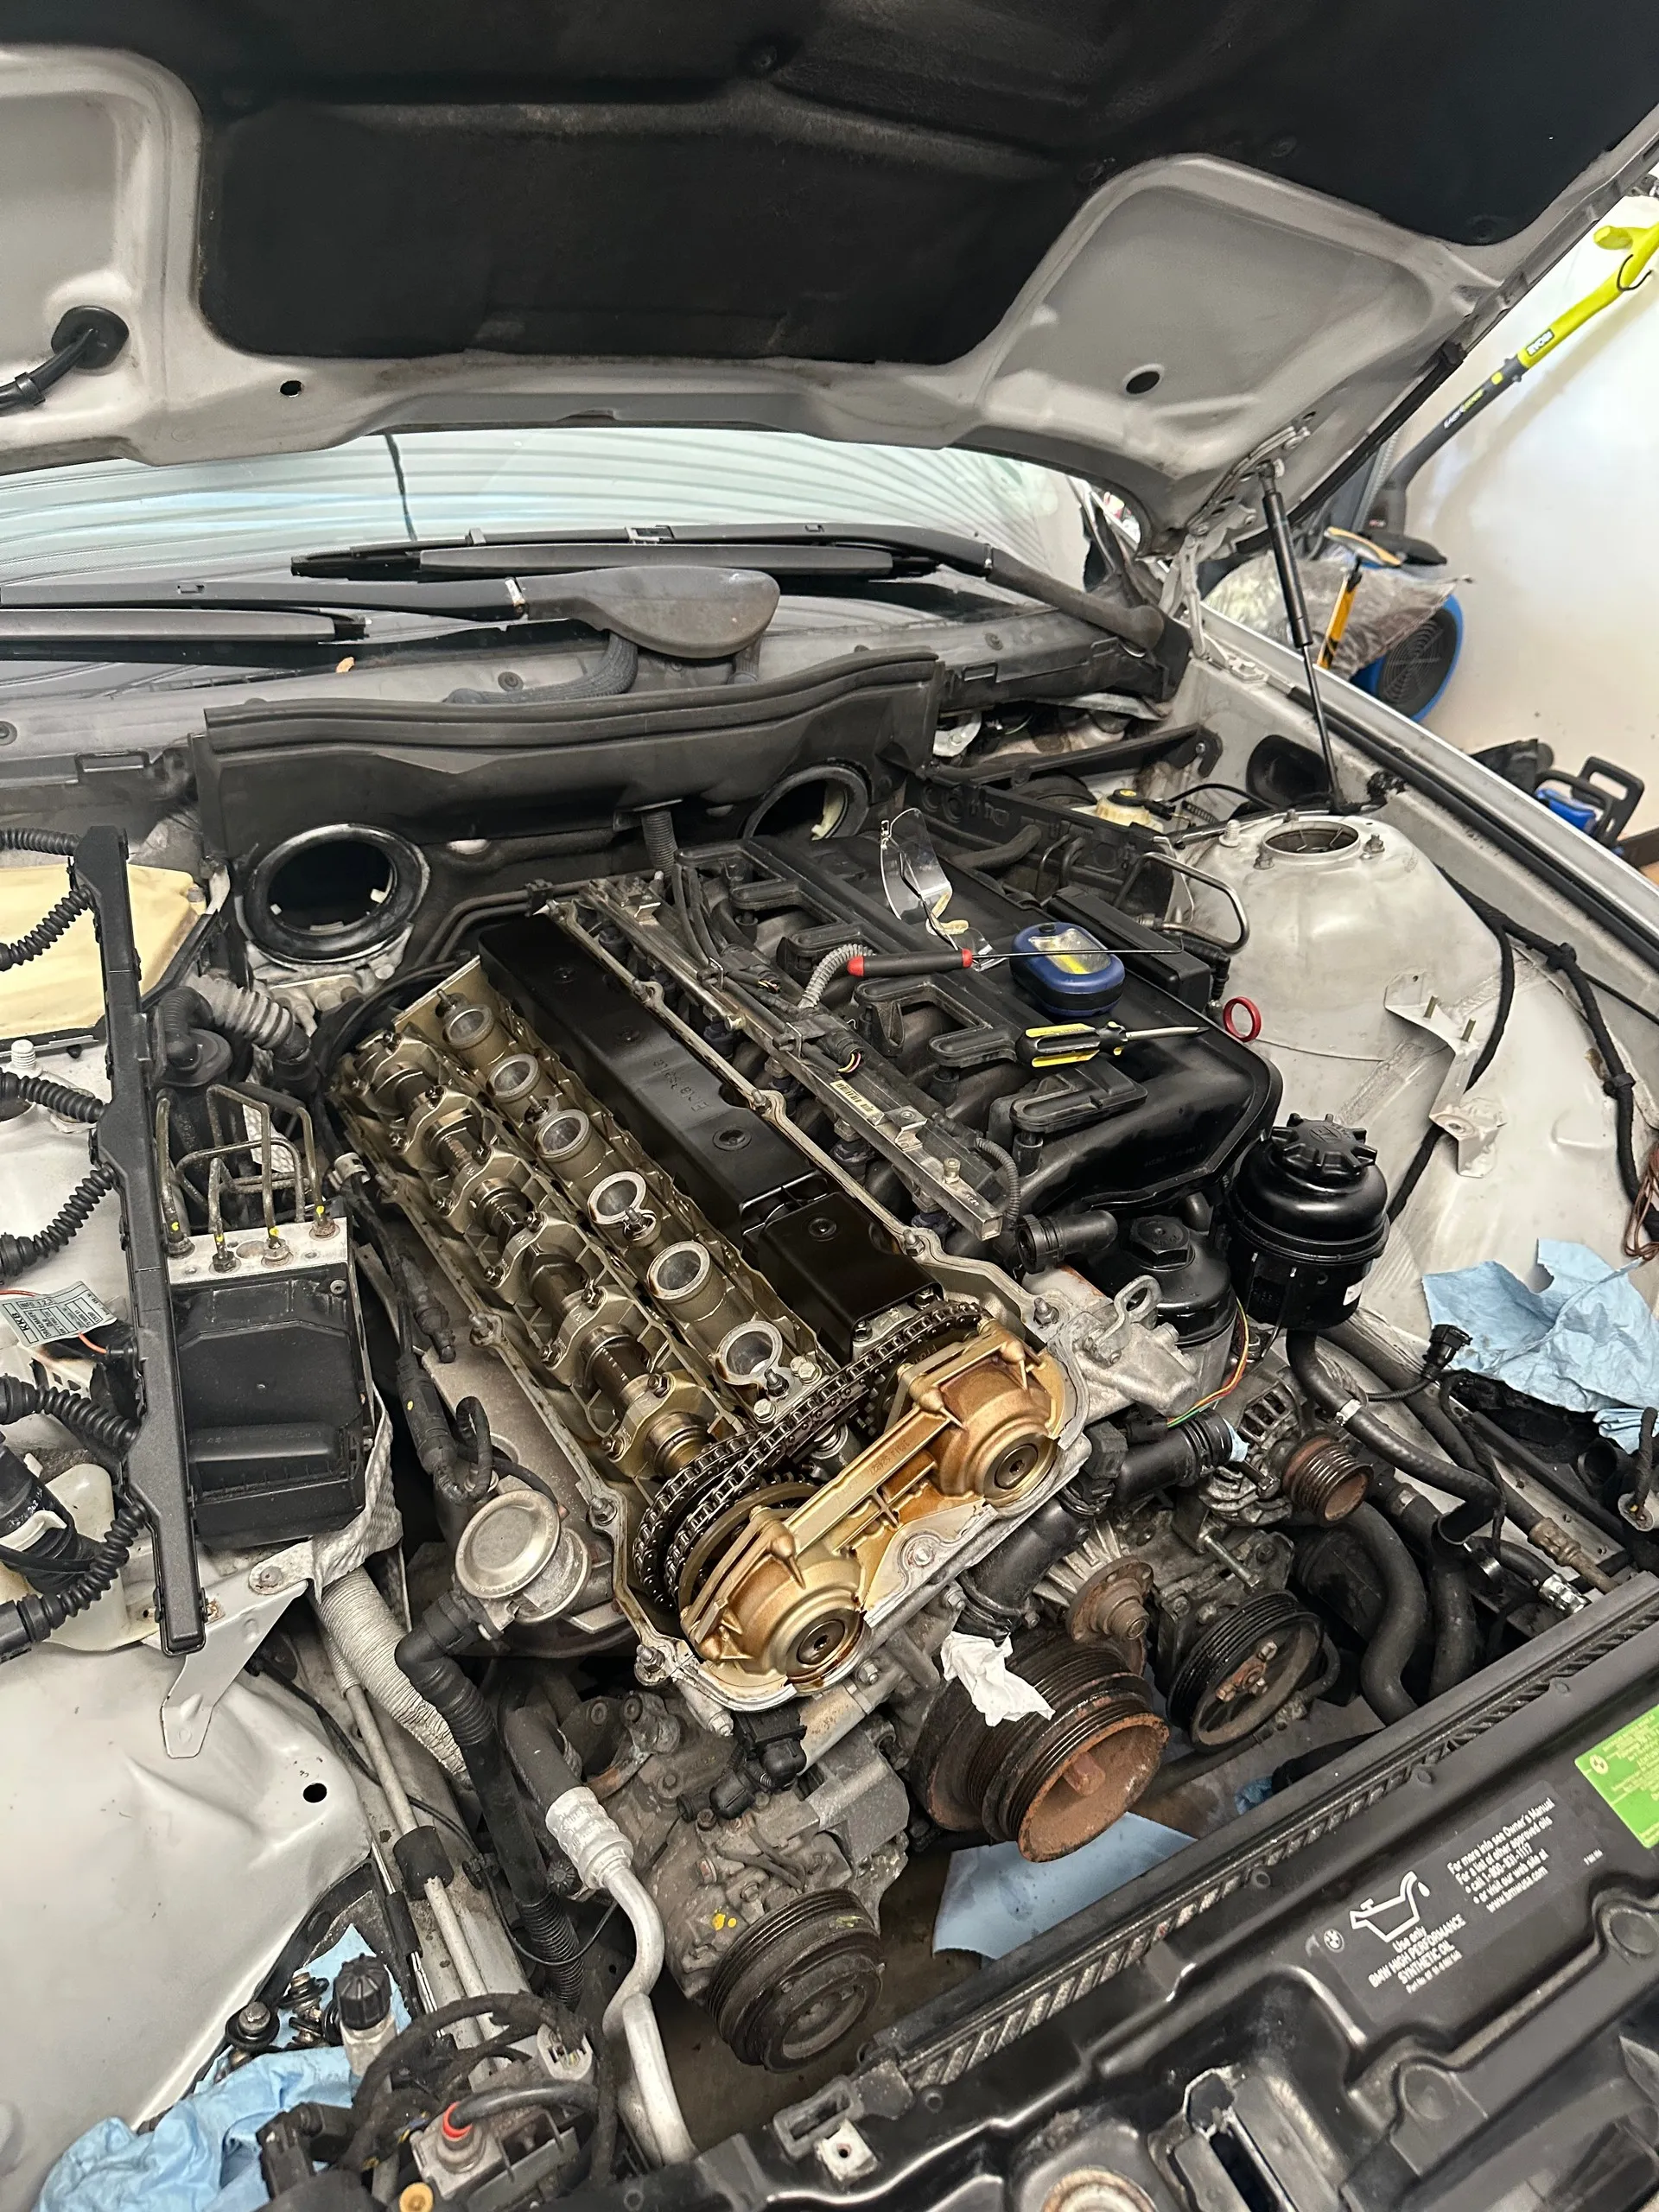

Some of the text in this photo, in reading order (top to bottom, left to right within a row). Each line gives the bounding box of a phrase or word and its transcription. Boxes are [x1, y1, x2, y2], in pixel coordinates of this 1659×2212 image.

[12, 1313, 29, 1331] KKB
[1447, 1860, 1462, 1874] For
[1455, 1871, 1470, 1885] For
[1486, 1866, 1548, 1913] www.bmwusa.com
[1369, 1965, 1391, 1987] BMW
[1389, 1952, 1413, 1974] HIGH
[1408, 1914, 1465, 1959] PERFORMANCE
[1393, 1926, 1429, 1953] Use only
[1398, 1948, 1441, 1984] SYNTHETIC
[1438, 1940, 1455, 1955] OIL
